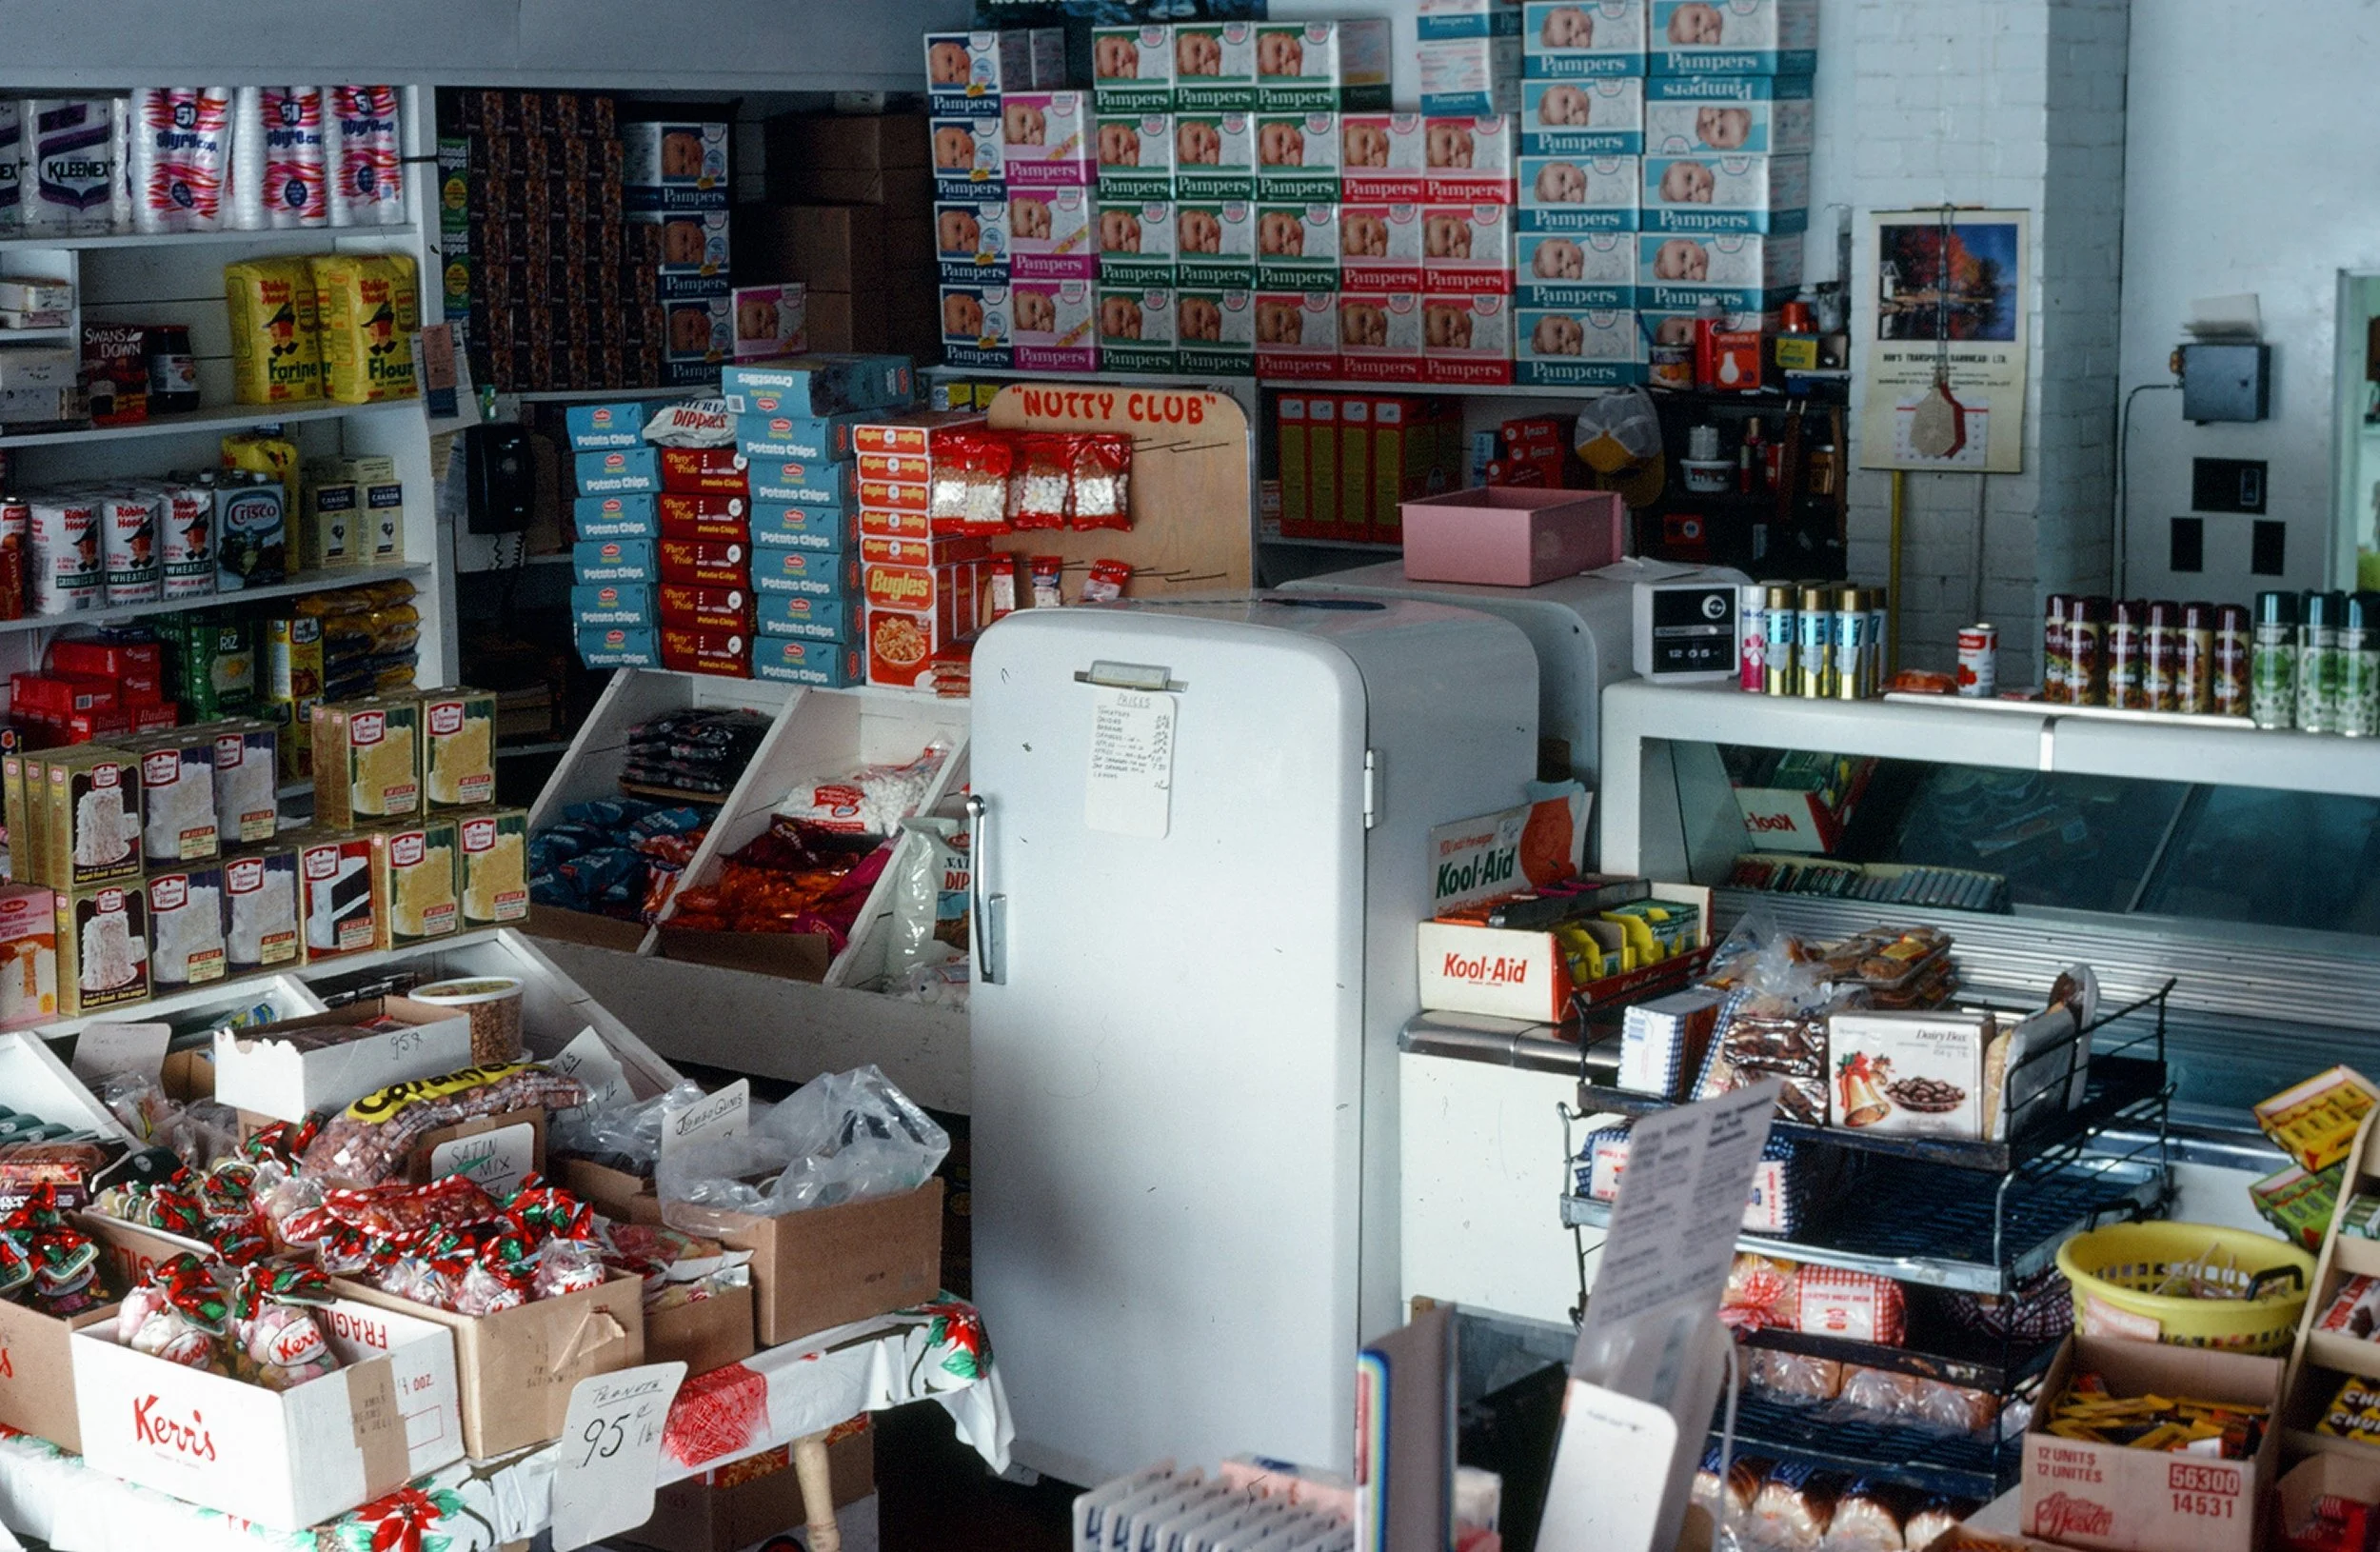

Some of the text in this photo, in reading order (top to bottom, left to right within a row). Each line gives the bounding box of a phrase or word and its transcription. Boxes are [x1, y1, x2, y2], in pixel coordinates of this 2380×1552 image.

[1540, 55, 1626, 73] Pampers
[1668, 52, 1756, 70] Pampers
[1663, 76, 1753, 100] Pampers
[934, 95, 998, 111] Pampers
[1097, 90, 1167, 108] Pampers
[1178, 88, 1251, 106] Pampers
[1259, 89, 1332, 107] Pampers
[1538, 132, 1623, 150] Pampers
[49, 161, 109, 183] KLEENEX
[1009, 162, 1078, 179] Pampers
[938, 180, 1001, 197] Pampers
[1100, 177, 1168, 194] Pampers
[1178, 176, 1251, 194] Pampers
[1260, 178, 1334, 195] Pampers
[1345, 179, 1418, 196] Pampers
[1428, 181, 1503, 200] Pampers
[1535, 210, 1619, 228] Pampers
[1659, 210, 1748, 229] Pampers
[942, 263, 1006, 280] Pampers
[1016, 255, 1082, 271] Pampers
[1101, 265, 1169, 282] Pampers
[1180, 263, 1250, 281] Pampers
[1259, 267, 1333, 286] Pampers
[1344, 269, 1417, 286] Pampers
[1427, 269, 1501, 288] Pampers
[1533, 286, 1617, 304] Pampers
[85, 328, 125, 345] SWANS
[101, 343, 141, 358] DOWN
[947, 346, 1008, 363] Pampers
[1020, 348, 1086, 365] Pampers
[1102, 349, 1171, 367] Pampers
[268, 358, 317, 380] Farine
[368, 358, 414, 379] Flour
[1343, 358, 1416, 375] Pampers
[1428, 359, 1501, 377] Pampers
[1533, 362, 1616, 380] Pampers
[577, 432, 637, 448] Potato Chips
[746, 442, 817, 458] Potato Chips
[587, 476, 649, 491] Potato Chips
[760, 487, 830, 504] Potato Chips
[116, 507, 147, 519] Robin
[230, 504, 277, 525] Crisco
[118, 518, 144, 528] Hood
[585, 521, 647, 535] Potato Chips
[762, 531, 829, 547] Potato Chips
[584, 567, 645, 580] Potato Chips
[762, 577, 829, 593] Potato Chips
[871, 569, 928, 600] Bugles
[582, 610, 641, 624] Potato Chips
[767, 620, 834, 637] Potato Chips
[220, 635, 238, 650] RIZ
[589, 653, 648, 666] Potato Chips
[763, 666, 828, 683] Potato Chips
[1117, 692, 1151, 708] PRICES
[1916, 1028, 1946, 1042] Dairy
[449, 1138, 498, 1171] SATIN
[479, 1155, 510, 1177] MIX
[593, 1381, 662, 1404] PEANUTS
[2038, 1446, 2096, 1466] 12 UNITS
[2037, 1462, 2050, 1476] 12
[2172, 1464, 2238, 1493] 56300
[2172, 1493, 2233, 1519] 14531
